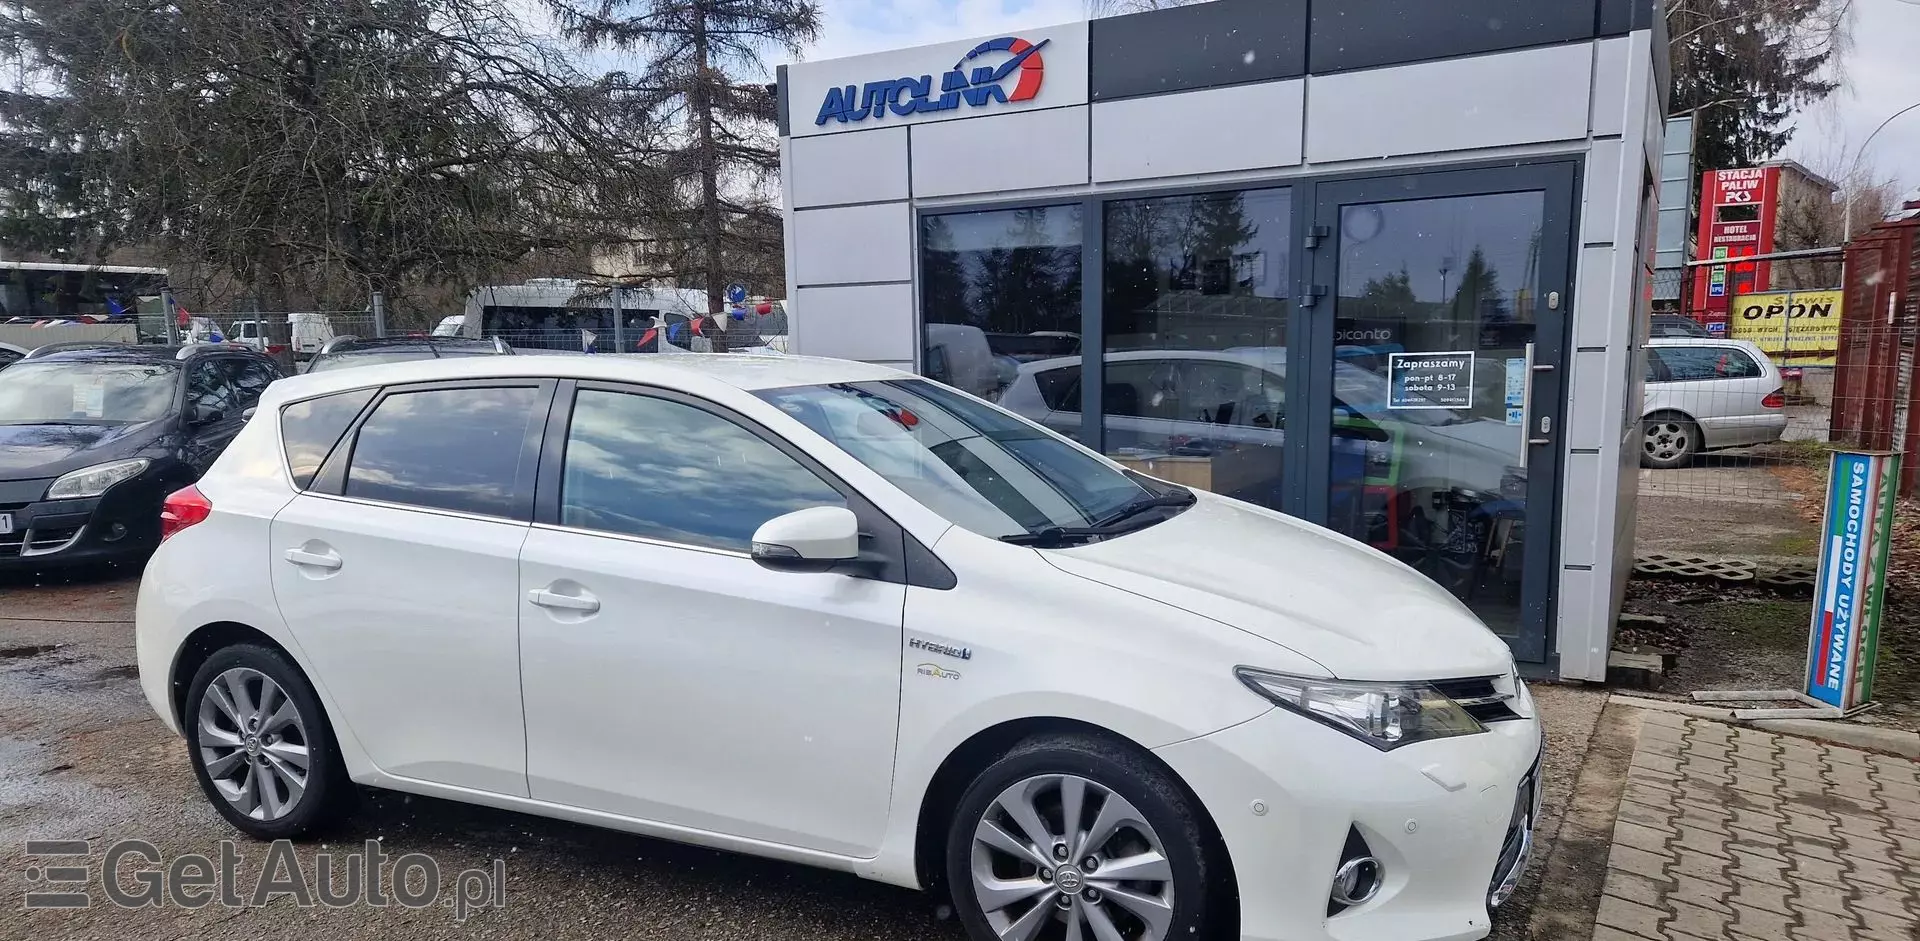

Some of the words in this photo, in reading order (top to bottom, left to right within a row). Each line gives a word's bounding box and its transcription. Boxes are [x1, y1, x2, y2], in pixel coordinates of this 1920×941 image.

[815, 66, 1009, 125] AUTOLINK
[1718, 169, 1763, 181] STACJA
[1721, 180, 1759, 191] PALIW
[1723, 226, 1747, 234] HOTEL
[1743, 303, 1832, 320] OPON
[1397, 359, 1465, 370] Zapraszamy
[1404, 374, 1434, 384] pon-pt
[1437, 373, 1457, 382] 8-17
[1404, 384, 1433, 392] sobota
[1437, 383, 1456, 391] 9-13
[1840, 461, 1865, 589] SAMOCHODY
[1828, 594, 1850, 691] UŻYWANE
